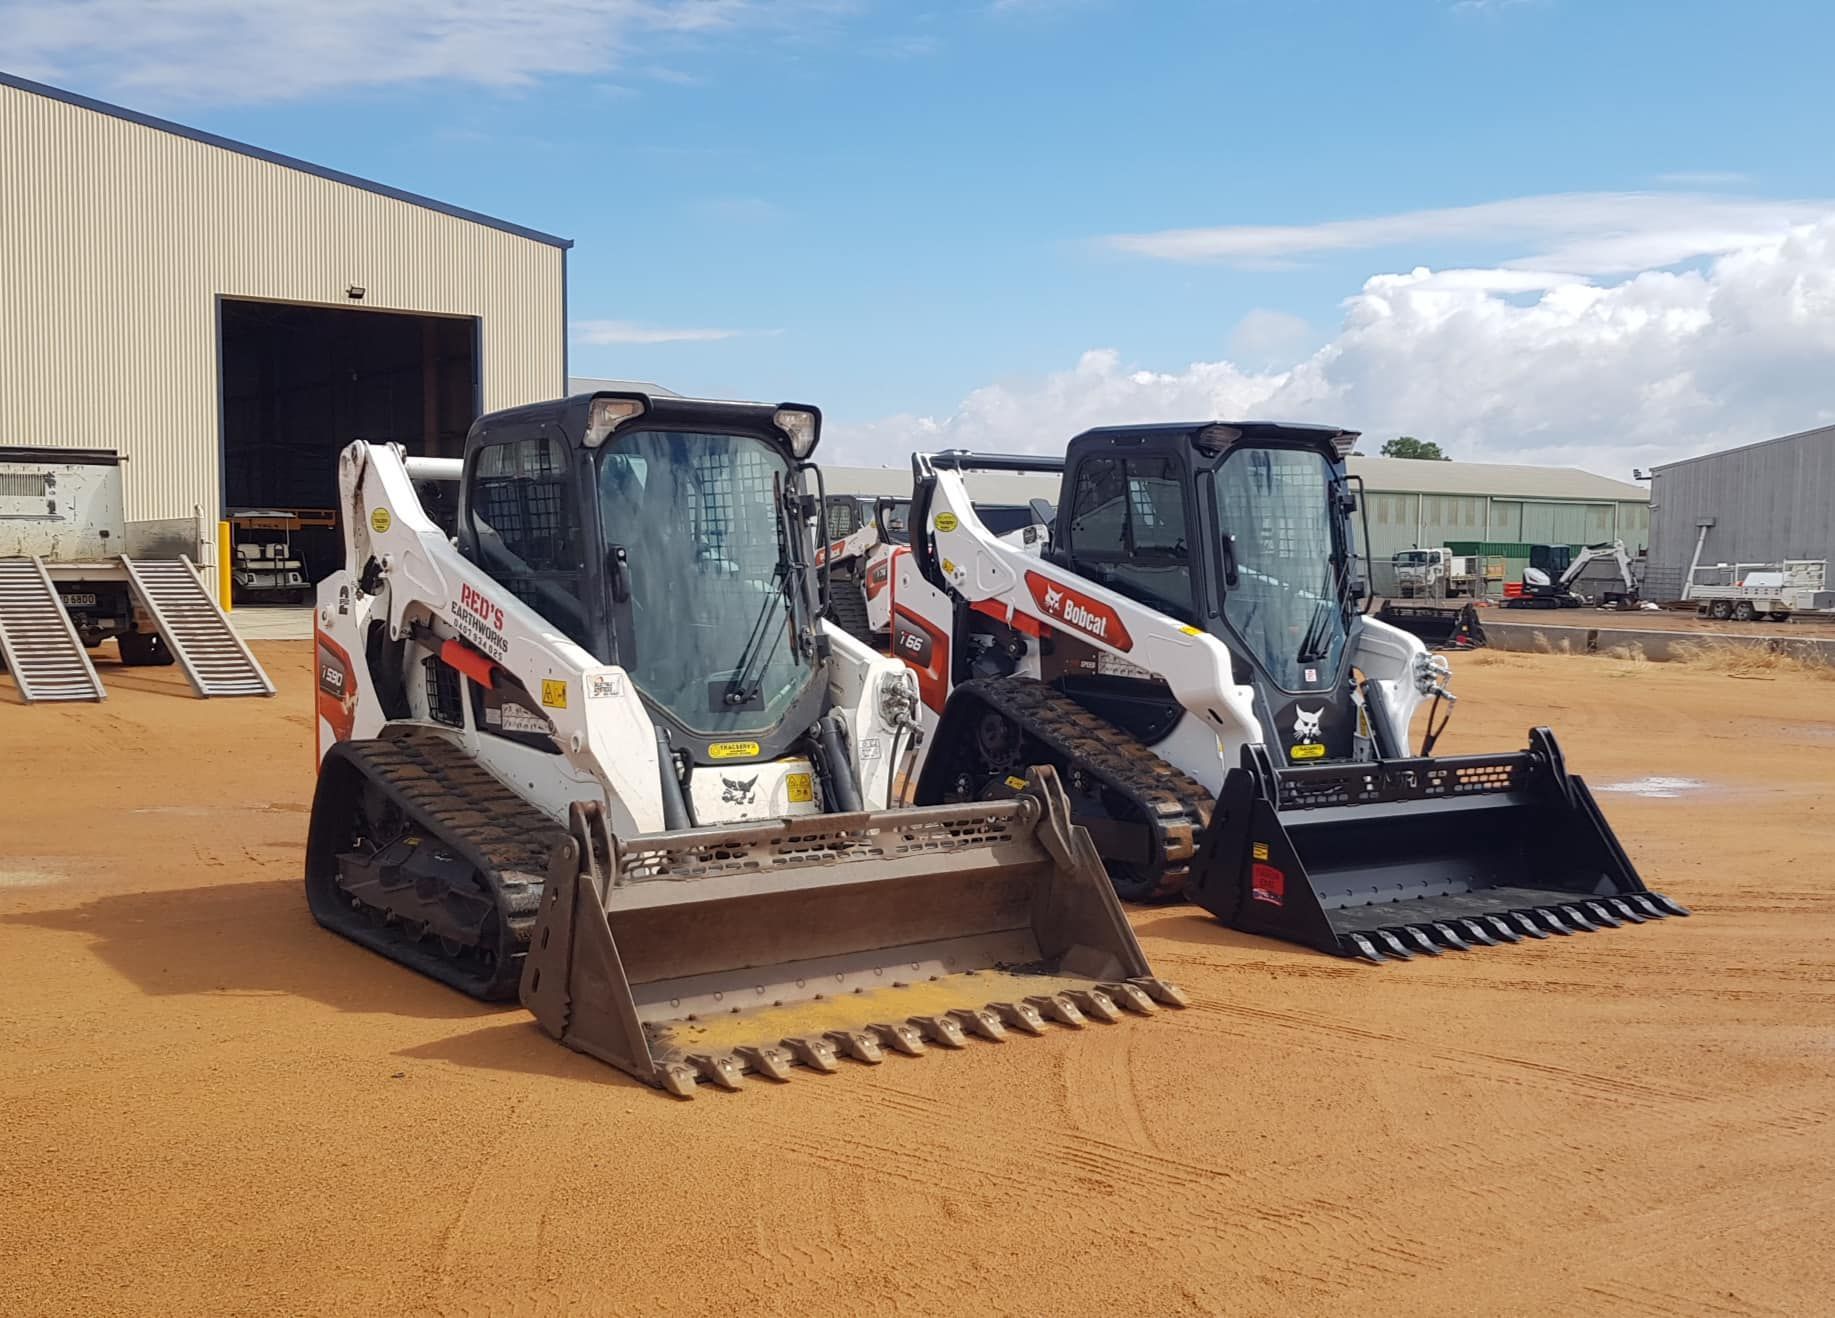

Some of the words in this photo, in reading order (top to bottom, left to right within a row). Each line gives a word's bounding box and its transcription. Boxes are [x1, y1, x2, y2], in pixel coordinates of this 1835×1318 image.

[451, 600, 509, 653] EARTHWORKS
[461, 583, 504, 631] RED'S
[1063, 599, 1107, 637] Bobcat
